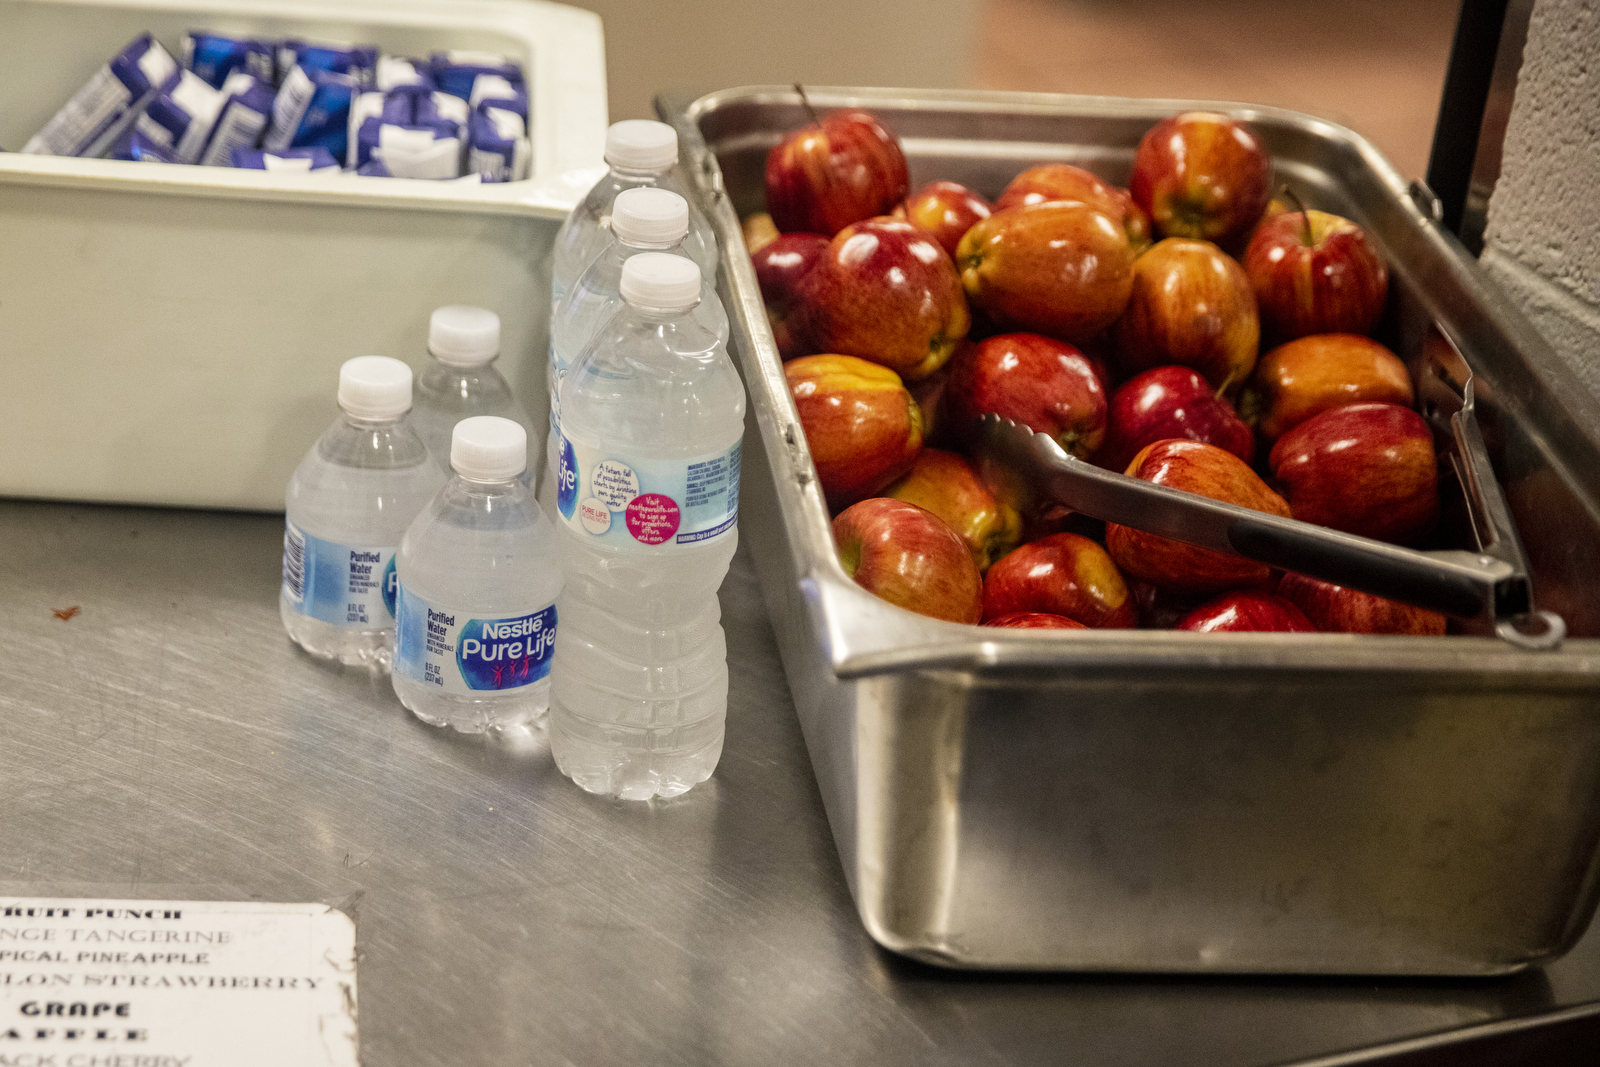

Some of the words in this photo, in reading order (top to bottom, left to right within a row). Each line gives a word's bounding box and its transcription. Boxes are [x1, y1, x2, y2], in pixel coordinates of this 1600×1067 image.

[582, 505, 595, 516] PURE
[595, 510, 607, 520] LIFE
[639, 510, 646, 518] to
[350, 551, 380, 563] Purified
[350, 562, 372, 575] Water
[428, 608, 455, 627] Purified
[427, 620, 448, 636] Water
[462, 639, 524, 662] Pure
[526, 628, 556, 660] Life
[0, 907, 76, 917] RUIT
[86, 908, 182, 919] PUNCH
[67, 929, 231, 944] TANGERINE
[77, 951, 210, 965] PINEAPPLE
[0, 973, 73, 986] LON
[83, 975, 324, 989] STRAWBERRY
[20, 1001, 130, 1018] GRAPE
[0, 1027, 148, 1042] APPLE
[66, 1053, 192, 1067] CHERRY
